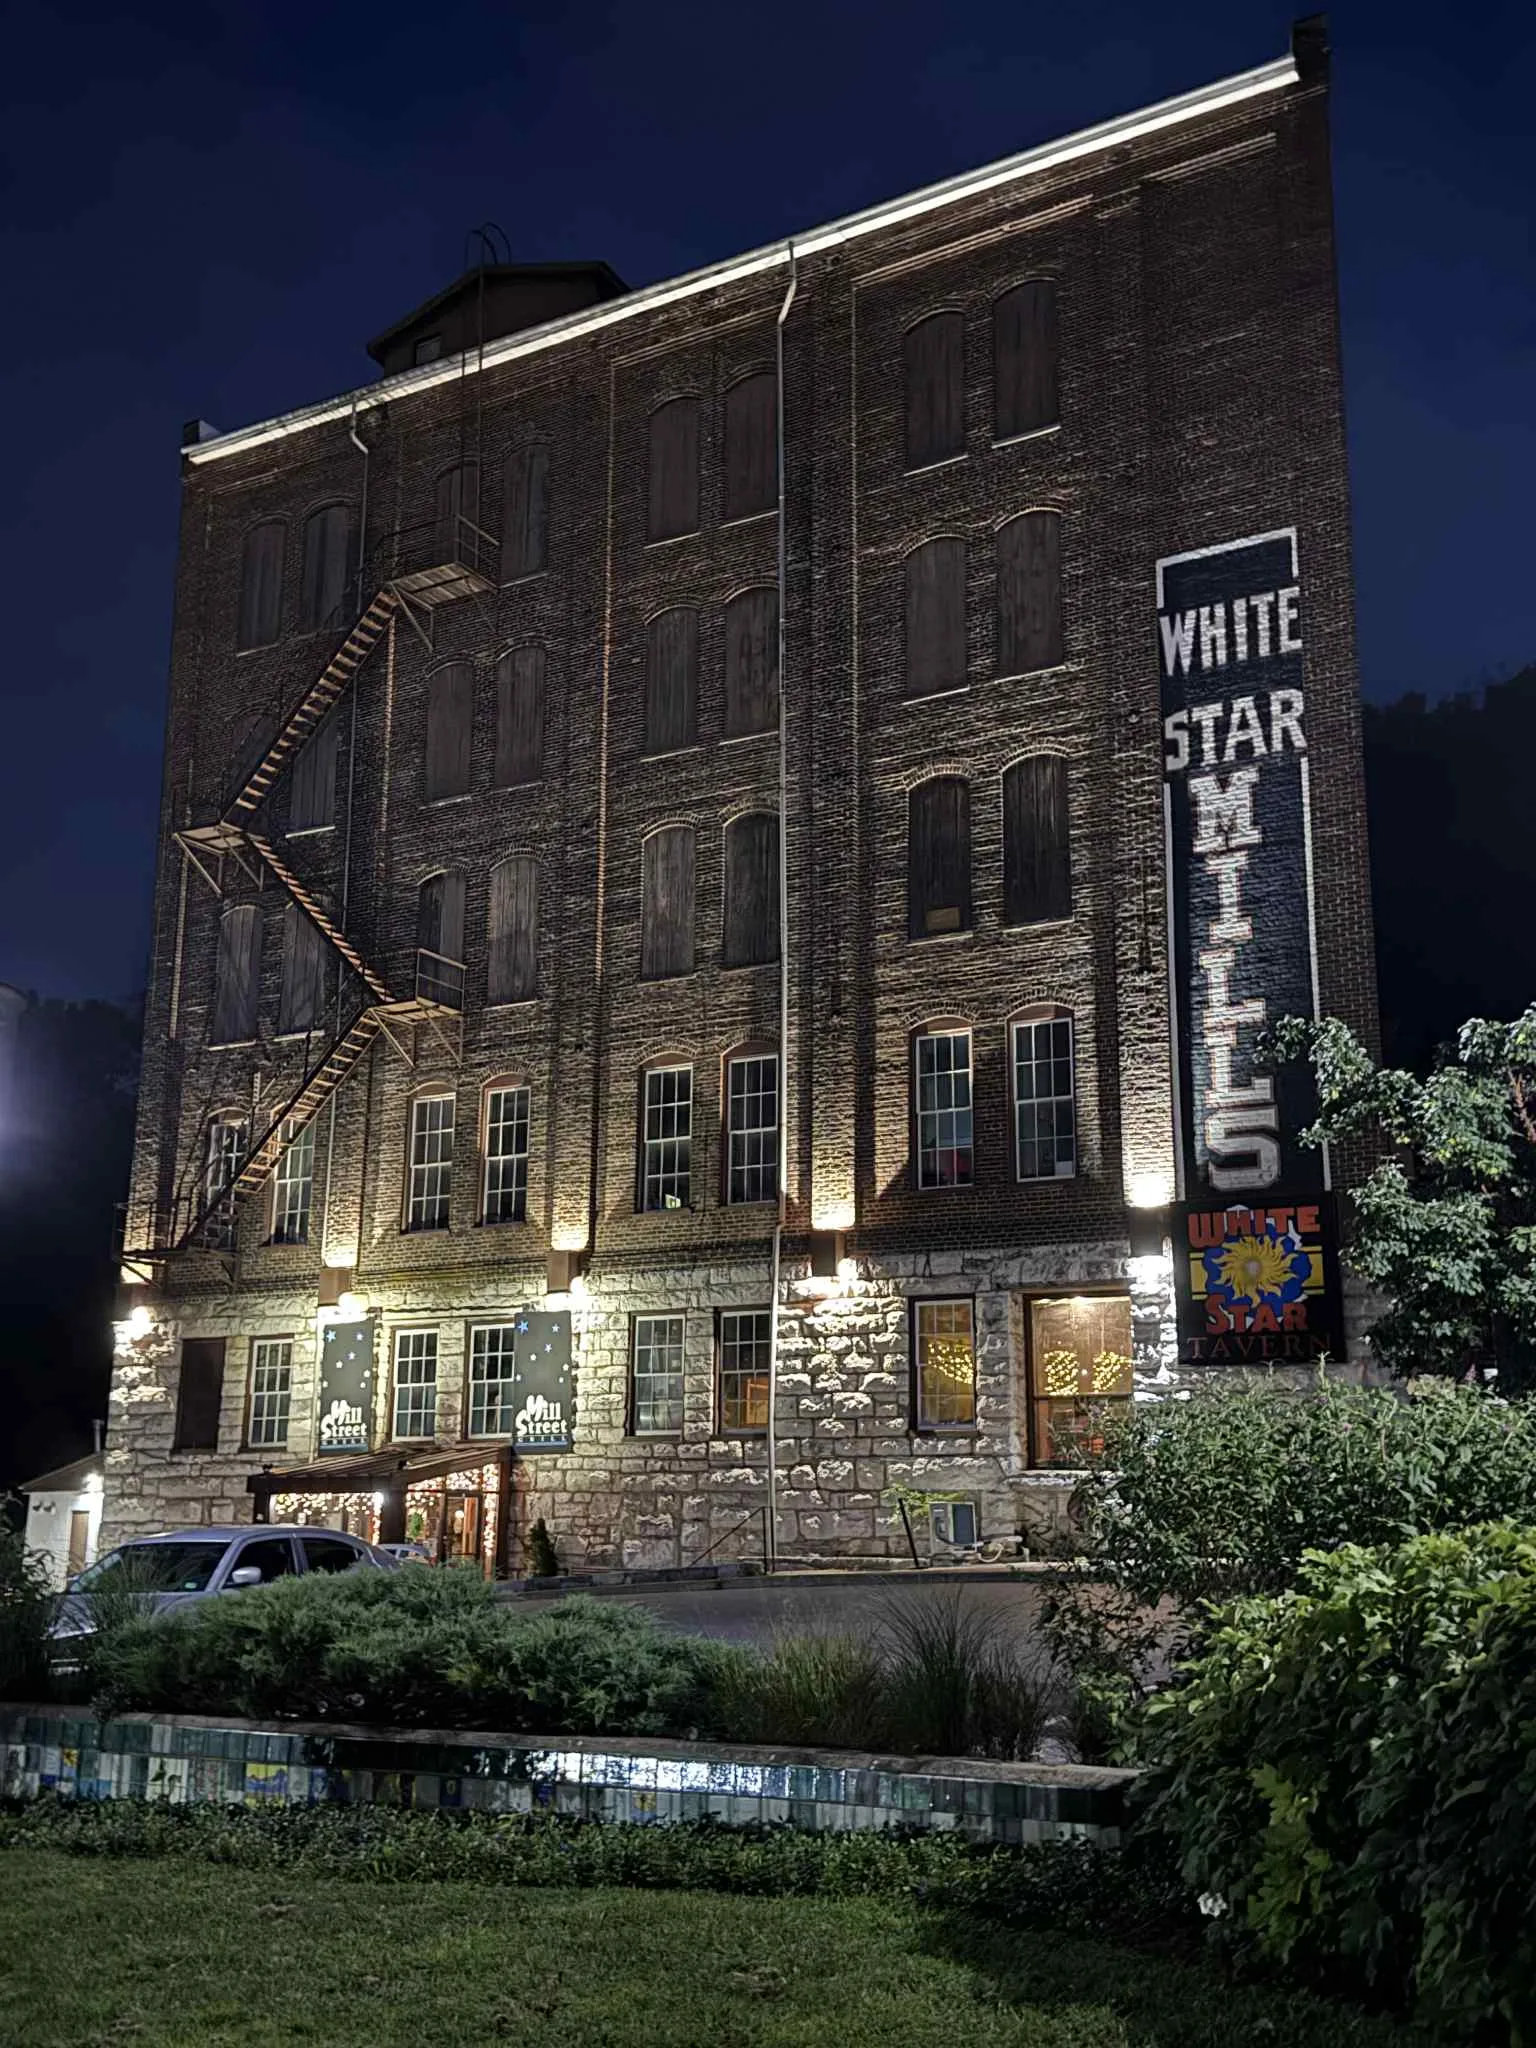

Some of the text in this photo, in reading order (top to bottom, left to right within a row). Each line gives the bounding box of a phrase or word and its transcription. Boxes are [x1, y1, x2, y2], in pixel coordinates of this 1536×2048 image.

[1159, 586, 1302, 676] WHITE
[1165, 688, 1307, 771] STAR
[1188, 766, 1281, 1191] MILLS
[1187, 1205, 1321, 1248] WHITE
[1205, 1294, 1308, 1335] STAR
[1187, 1334, 1331, 1359] TAVERN
[331, 1399, 362, 1425] Mill
[515, 1409, 567, 1437] Street
[526, 1394, 561, 1422] Mill
[320, 1414, 367, 1440] Street
